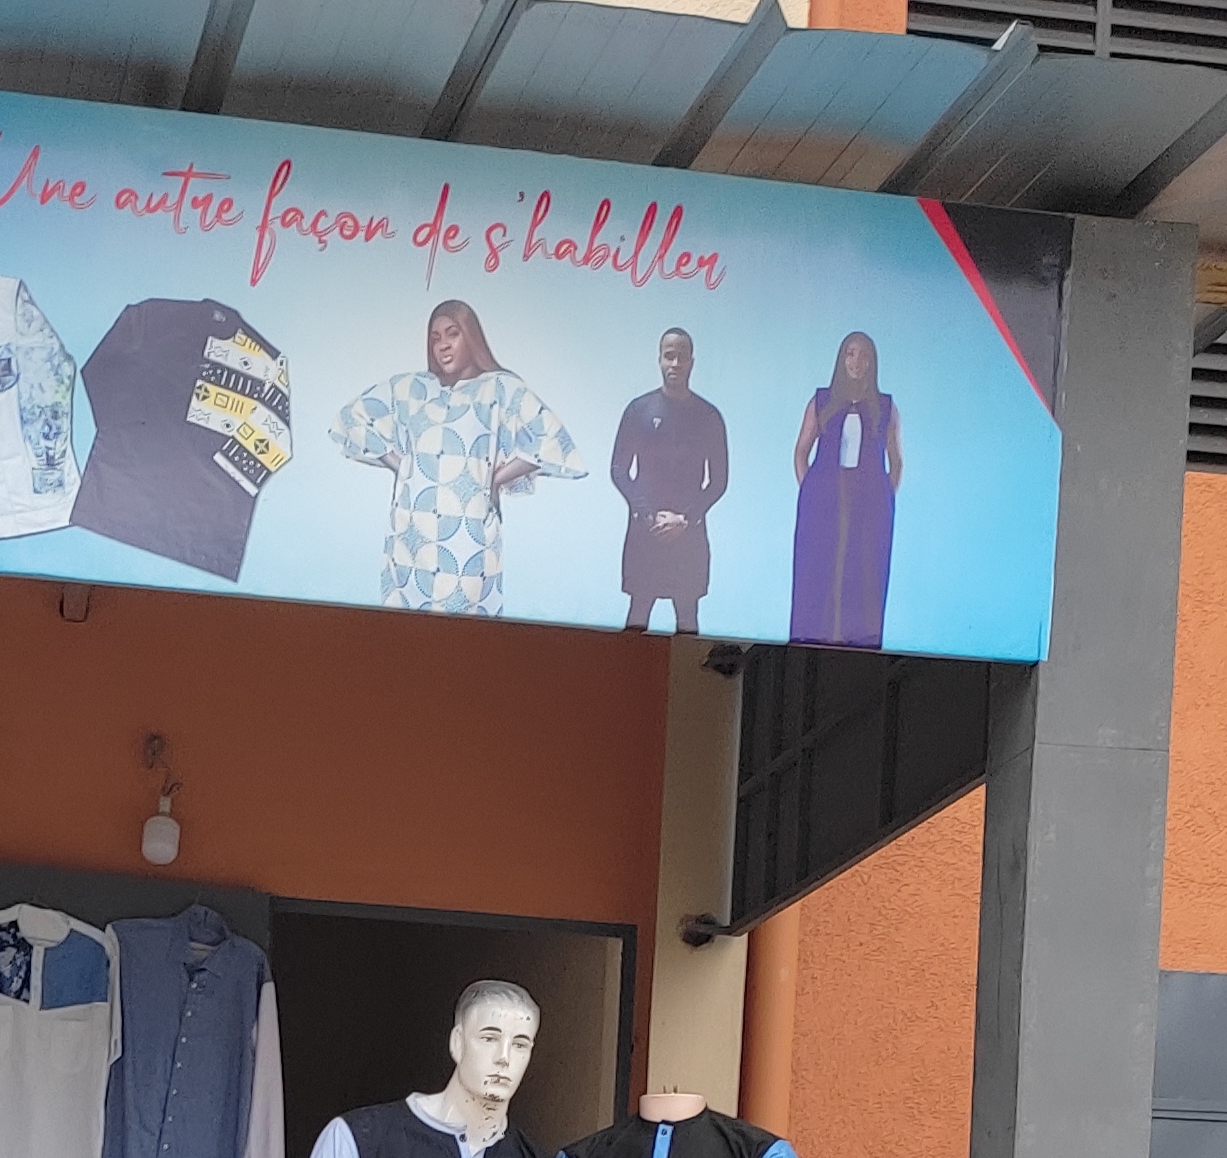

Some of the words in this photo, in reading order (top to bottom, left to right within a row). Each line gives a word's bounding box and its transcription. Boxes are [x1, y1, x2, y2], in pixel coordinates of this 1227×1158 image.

[114, 162, 244, 234] autre
[250, 158, 397, 288] façon
[412, 182, 471, 292] de
[484, 189, 726, 291] s'habiller
